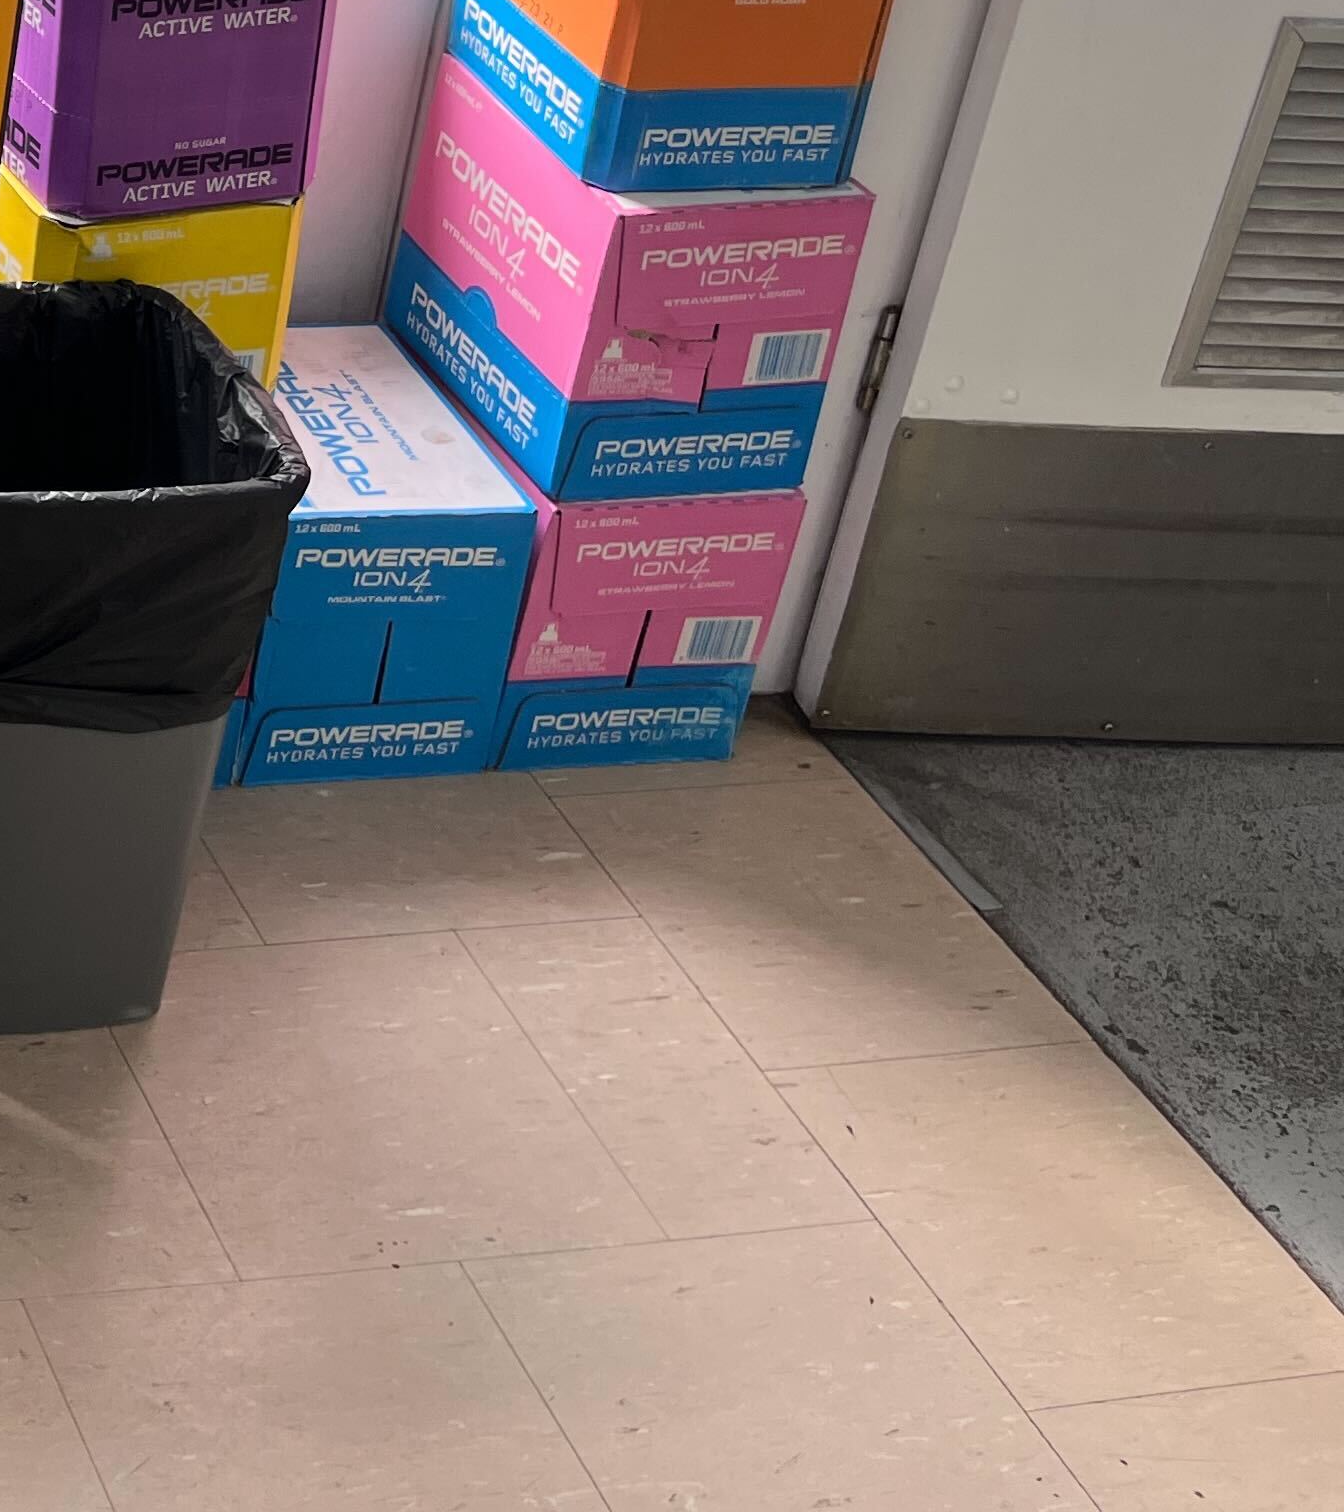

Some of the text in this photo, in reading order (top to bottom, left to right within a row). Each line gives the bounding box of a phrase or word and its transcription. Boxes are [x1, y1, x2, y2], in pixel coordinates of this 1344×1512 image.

[138, 15, 214, 39] ACTIVE
[642, 124, 834, 149] POWERADE
[295, 545, 499, 568] POWERADE
